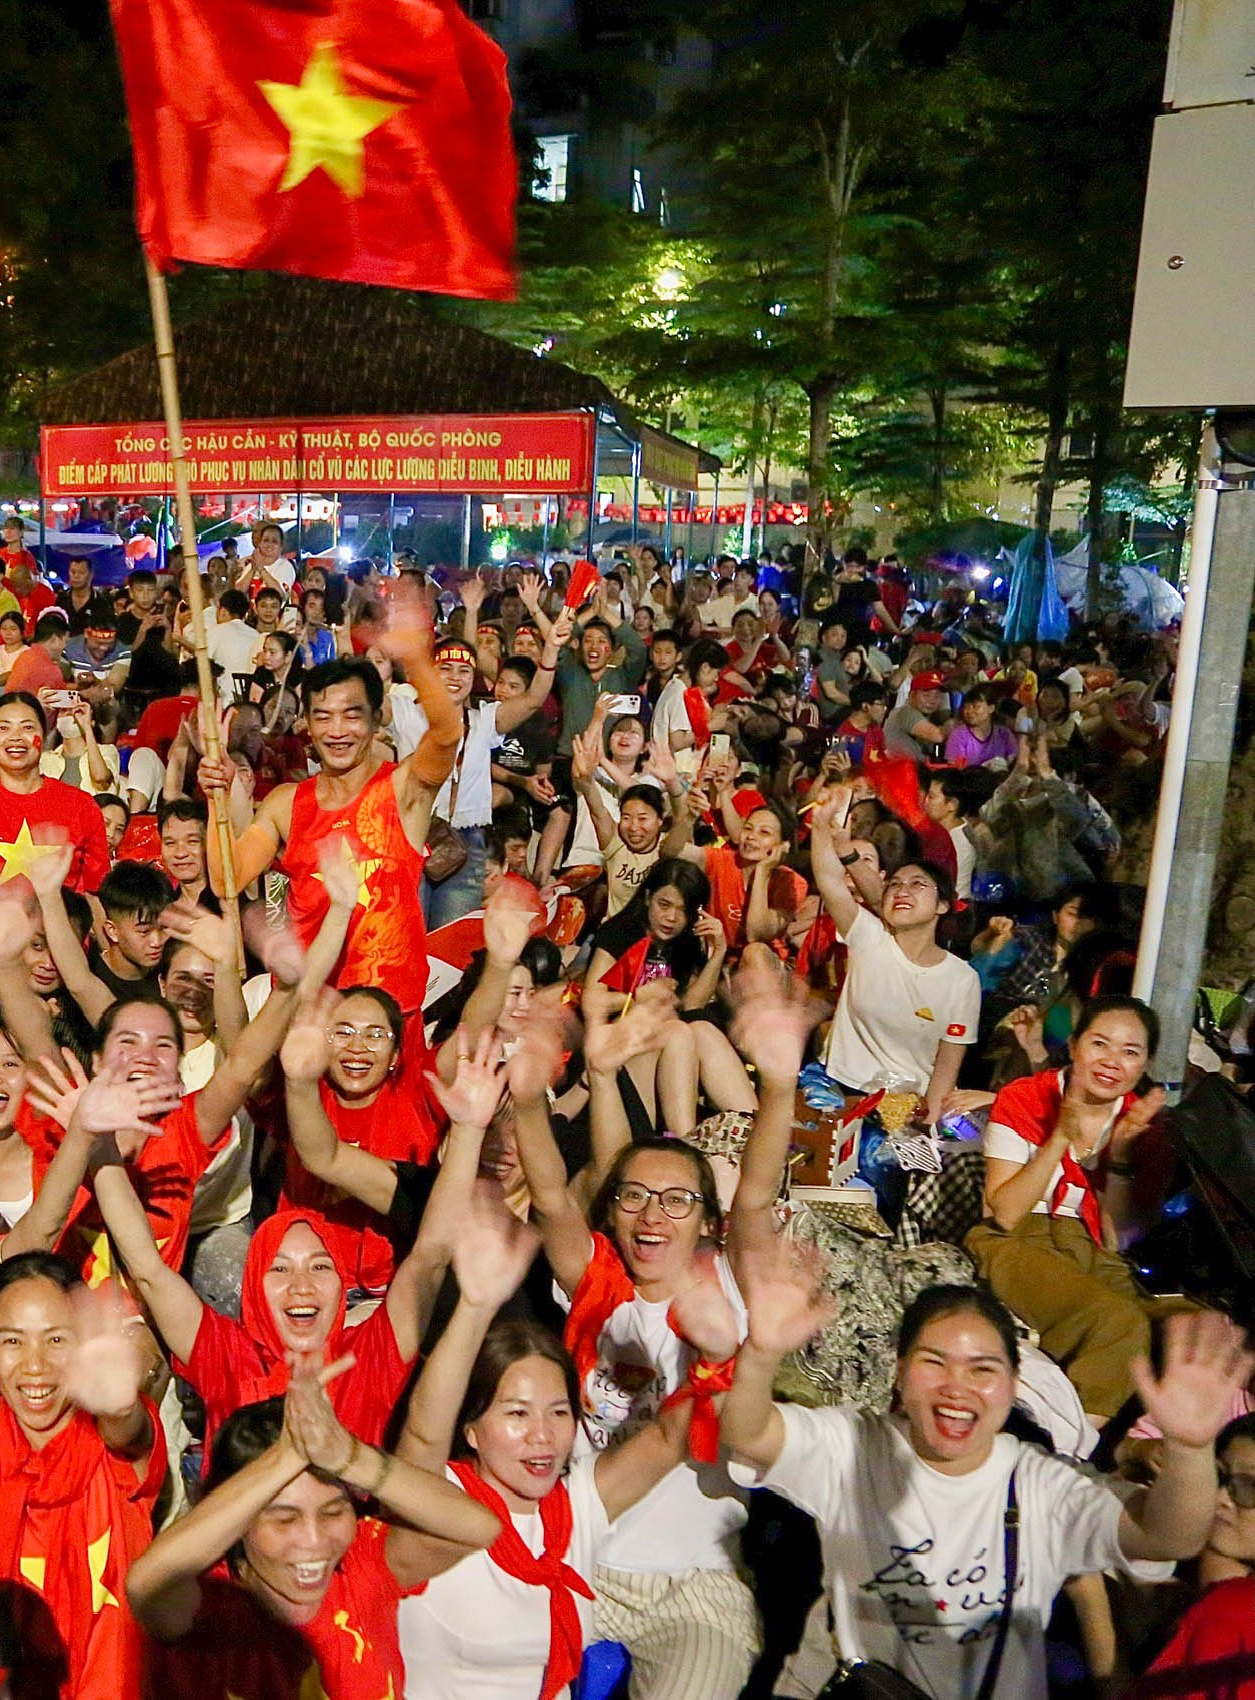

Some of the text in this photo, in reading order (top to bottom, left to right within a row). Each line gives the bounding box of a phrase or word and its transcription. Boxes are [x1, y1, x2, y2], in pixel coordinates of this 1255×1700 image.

[115, 426, 502, 454] TỔNG CC HẬU CẦN KỸ THUẬT, BỘ QUỐC PHÒNG
[88, 457, 108, 484] CẤP
[111, 459, 137, 484] PHÁT
[183, 457, 198, 482] HÔ
[201, 461, 230, 486] PHỤC
[233, 461, 246, 485] VỤ
[249, 456, 280, 480] NHÂN
[283, 455, 306, 480] DÂN
[309, 451, 325, 480] CỔ
[328, 455, 342, 480] VŨ
[346, 454, 368, 480] CÁC
[372, 457, 394, 485] LỰC
[397, 457, 435, 485] LƯỢNG
[469, 458, 502, 483] BINH,
[536, 454, 571, 480] HÀNH
